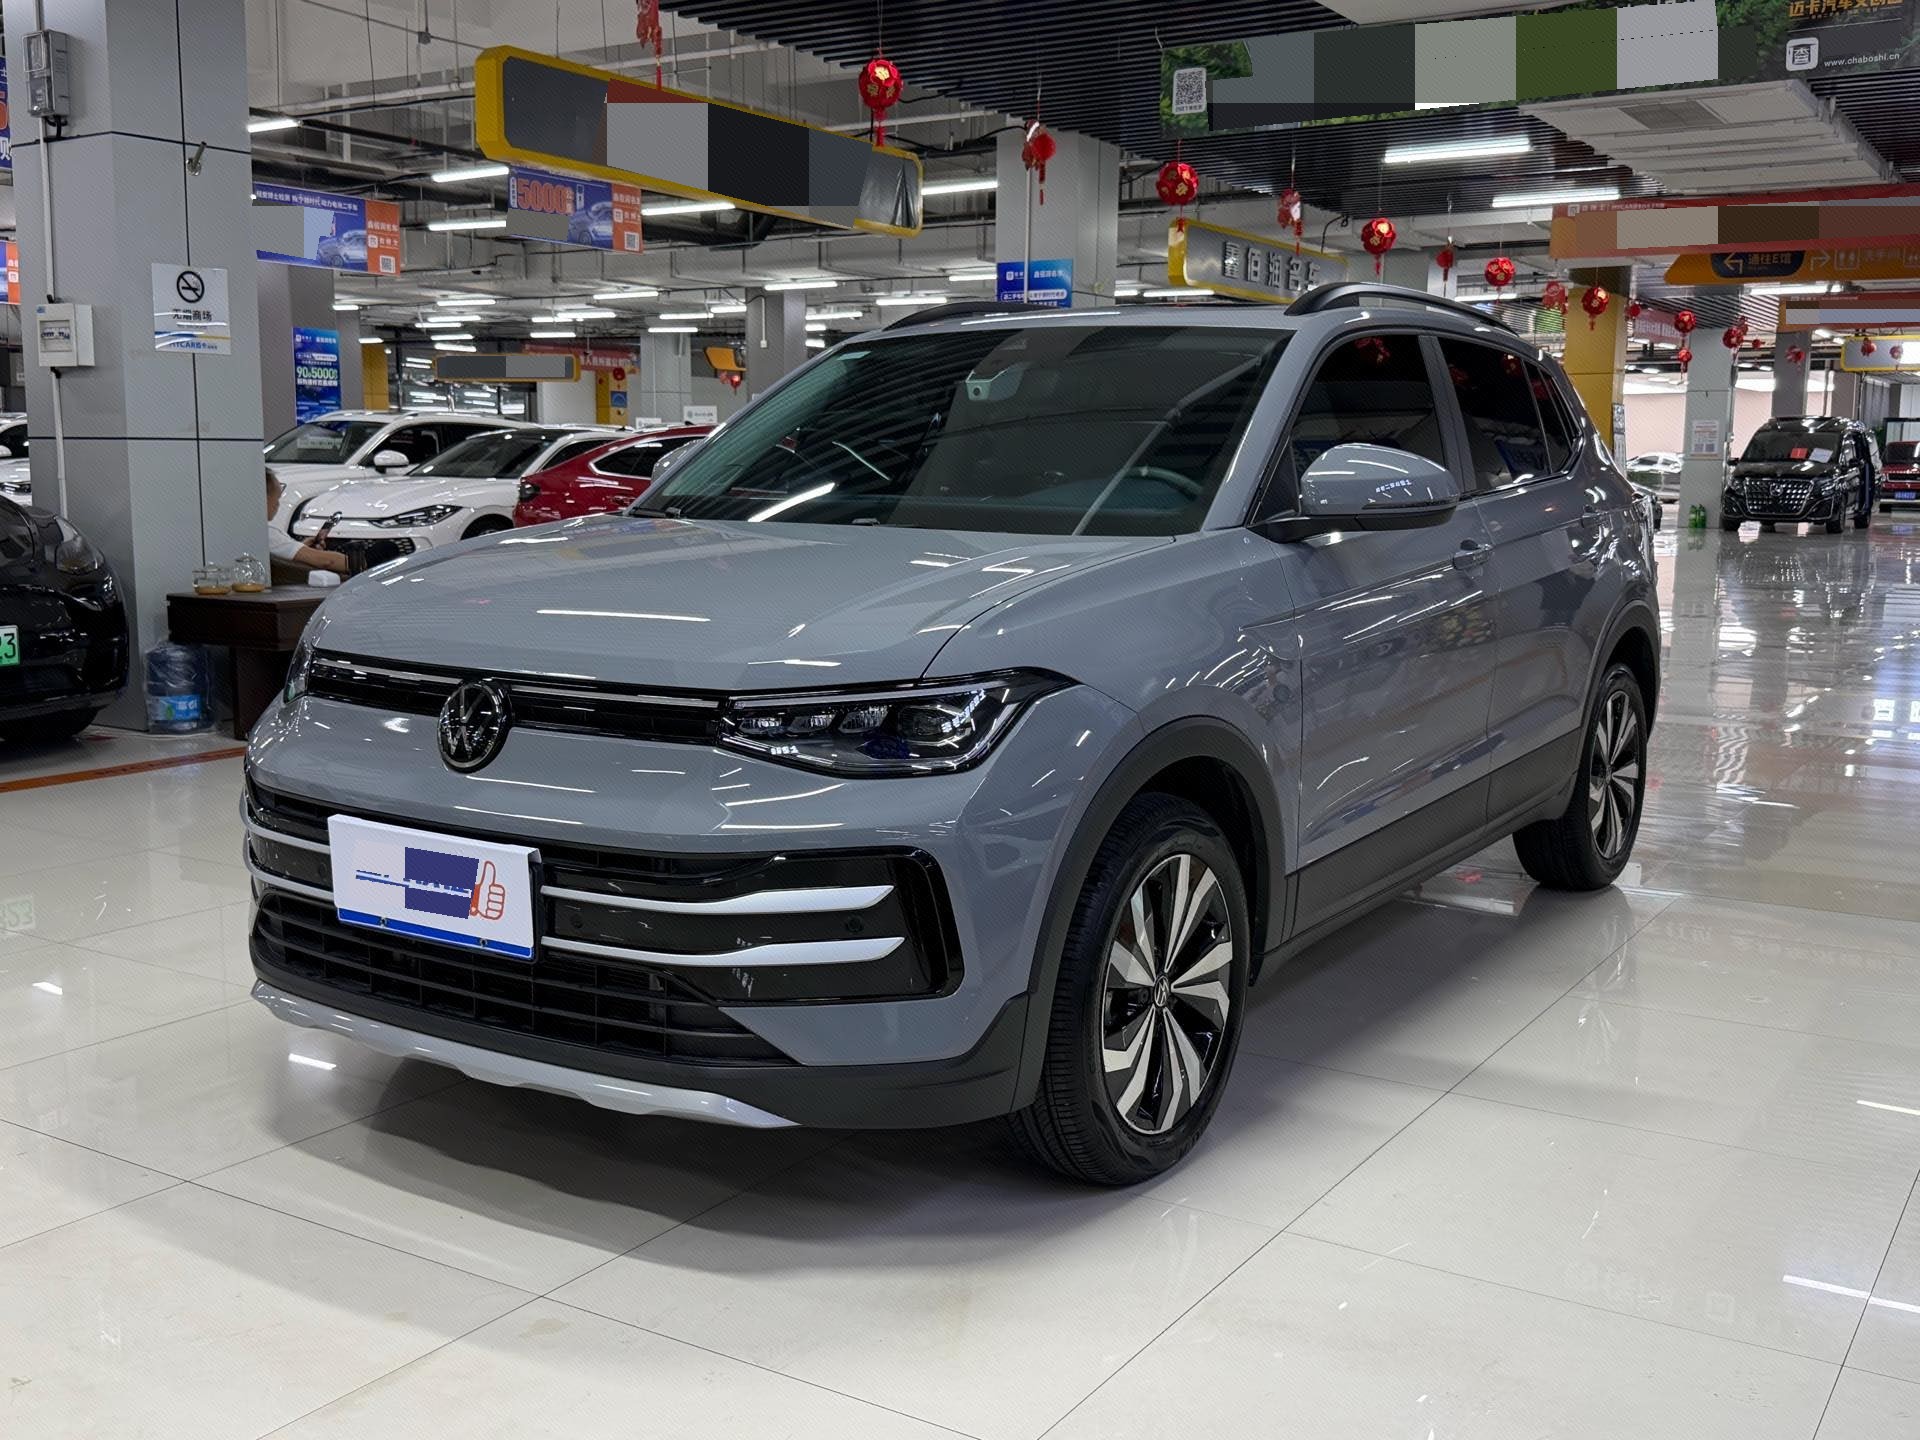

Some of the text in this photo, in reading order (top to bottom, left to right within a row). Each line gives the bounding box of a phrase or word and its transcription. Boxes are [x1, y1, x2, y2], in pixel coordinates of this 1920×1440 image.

[1823, 53, 1901, 68] www.chaboshi.cn
[1748, 253, 1792, 265] 通往E馆
[0, 632, 16, 659] 3
